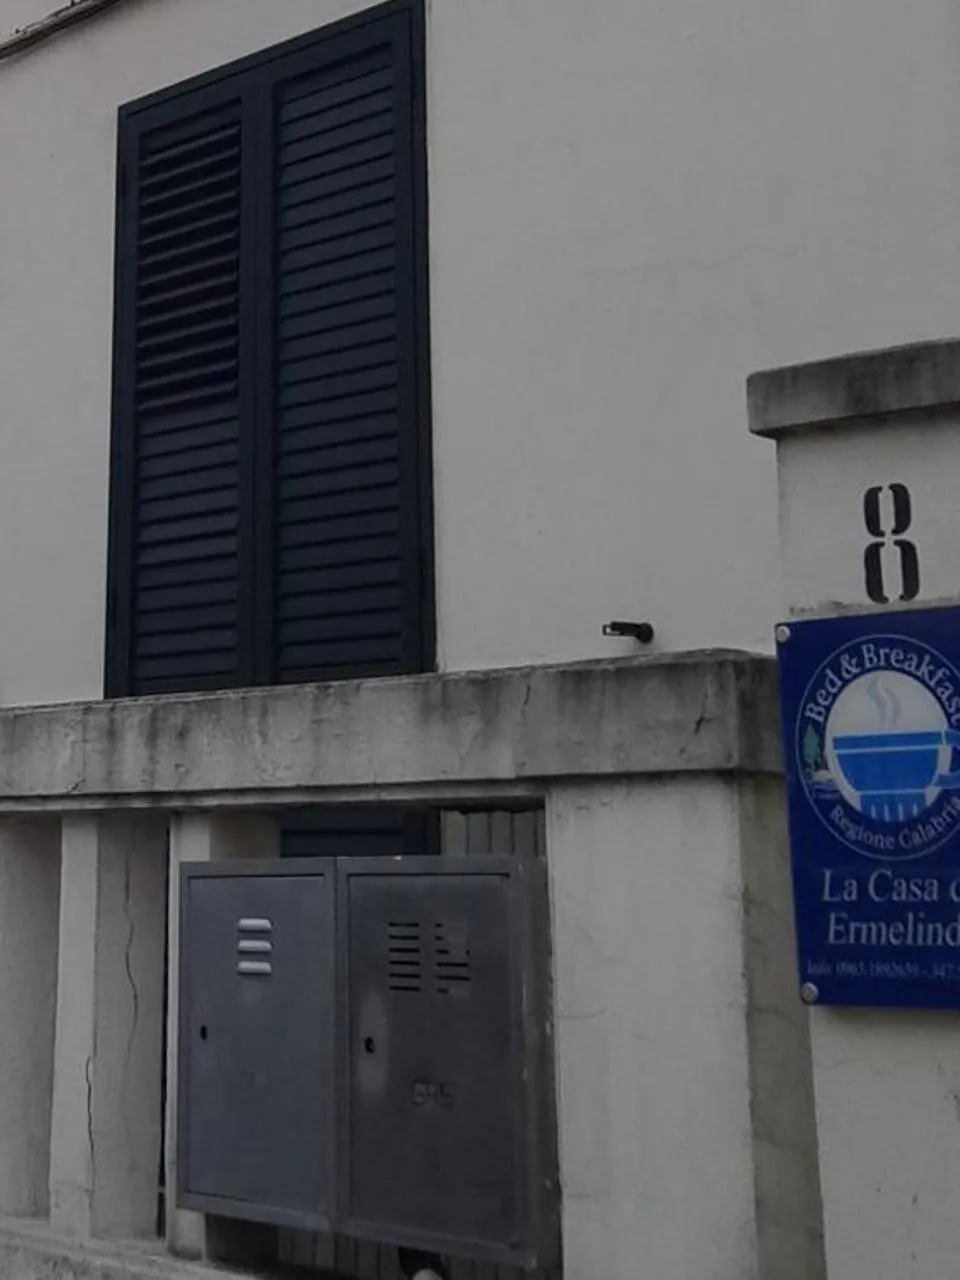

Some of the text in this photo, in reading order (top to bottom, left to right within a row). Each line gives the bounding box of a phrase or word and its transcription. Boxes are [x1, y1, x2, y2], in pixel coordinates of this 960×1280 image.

[863, 482, 920, 605] 8
[804, 668, 843, 724] Bed
[838, 653, 862, 678] &
[829, 804, 897, 851] Regione
[822, 867, 858, 903] La
[868, 868, 939, 903] Casa
